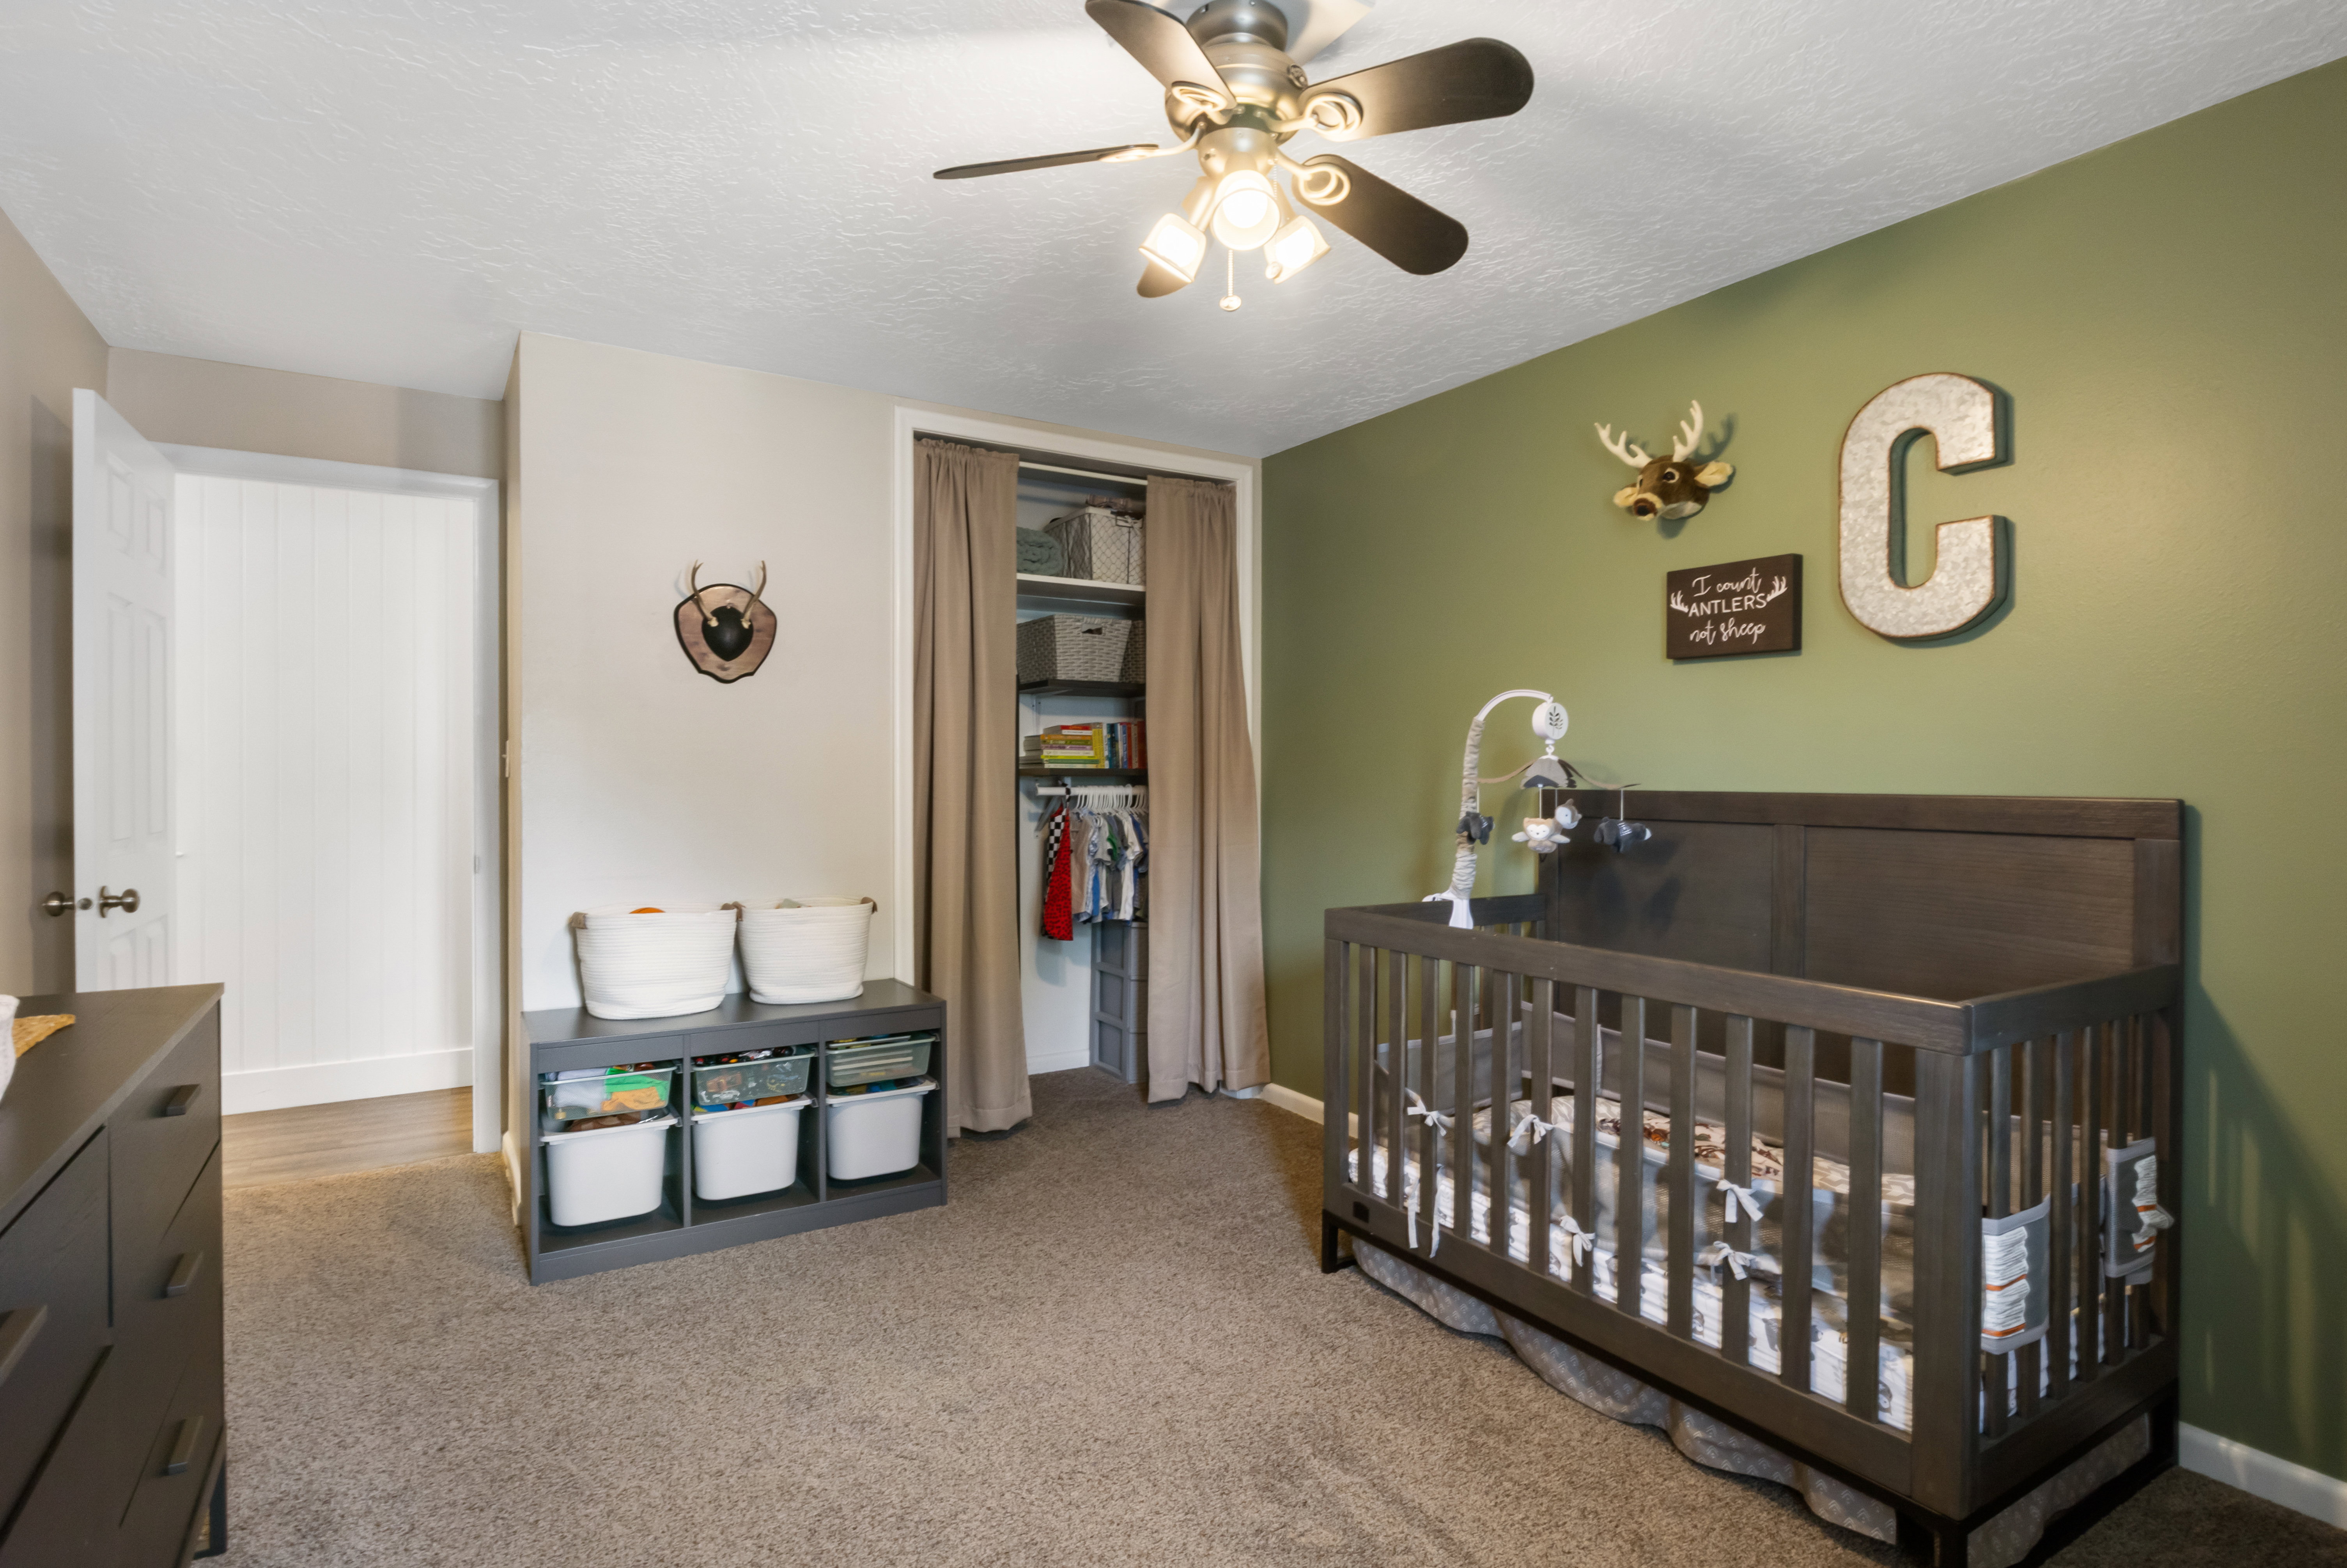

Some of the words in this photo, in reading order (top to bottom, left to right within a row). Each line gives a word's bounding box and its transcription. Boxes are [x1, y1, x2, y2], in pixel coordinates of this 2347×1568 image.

[1839, 372, 1995, 638] C
[1692, 574, 1712, 597] I
[1716, 567, 1762, 594] count
[1688, 593, 1767, 617] ANTLERS
[1690, 619, 1716, 645] not
[1720, 617, 1766, 644] sheep
